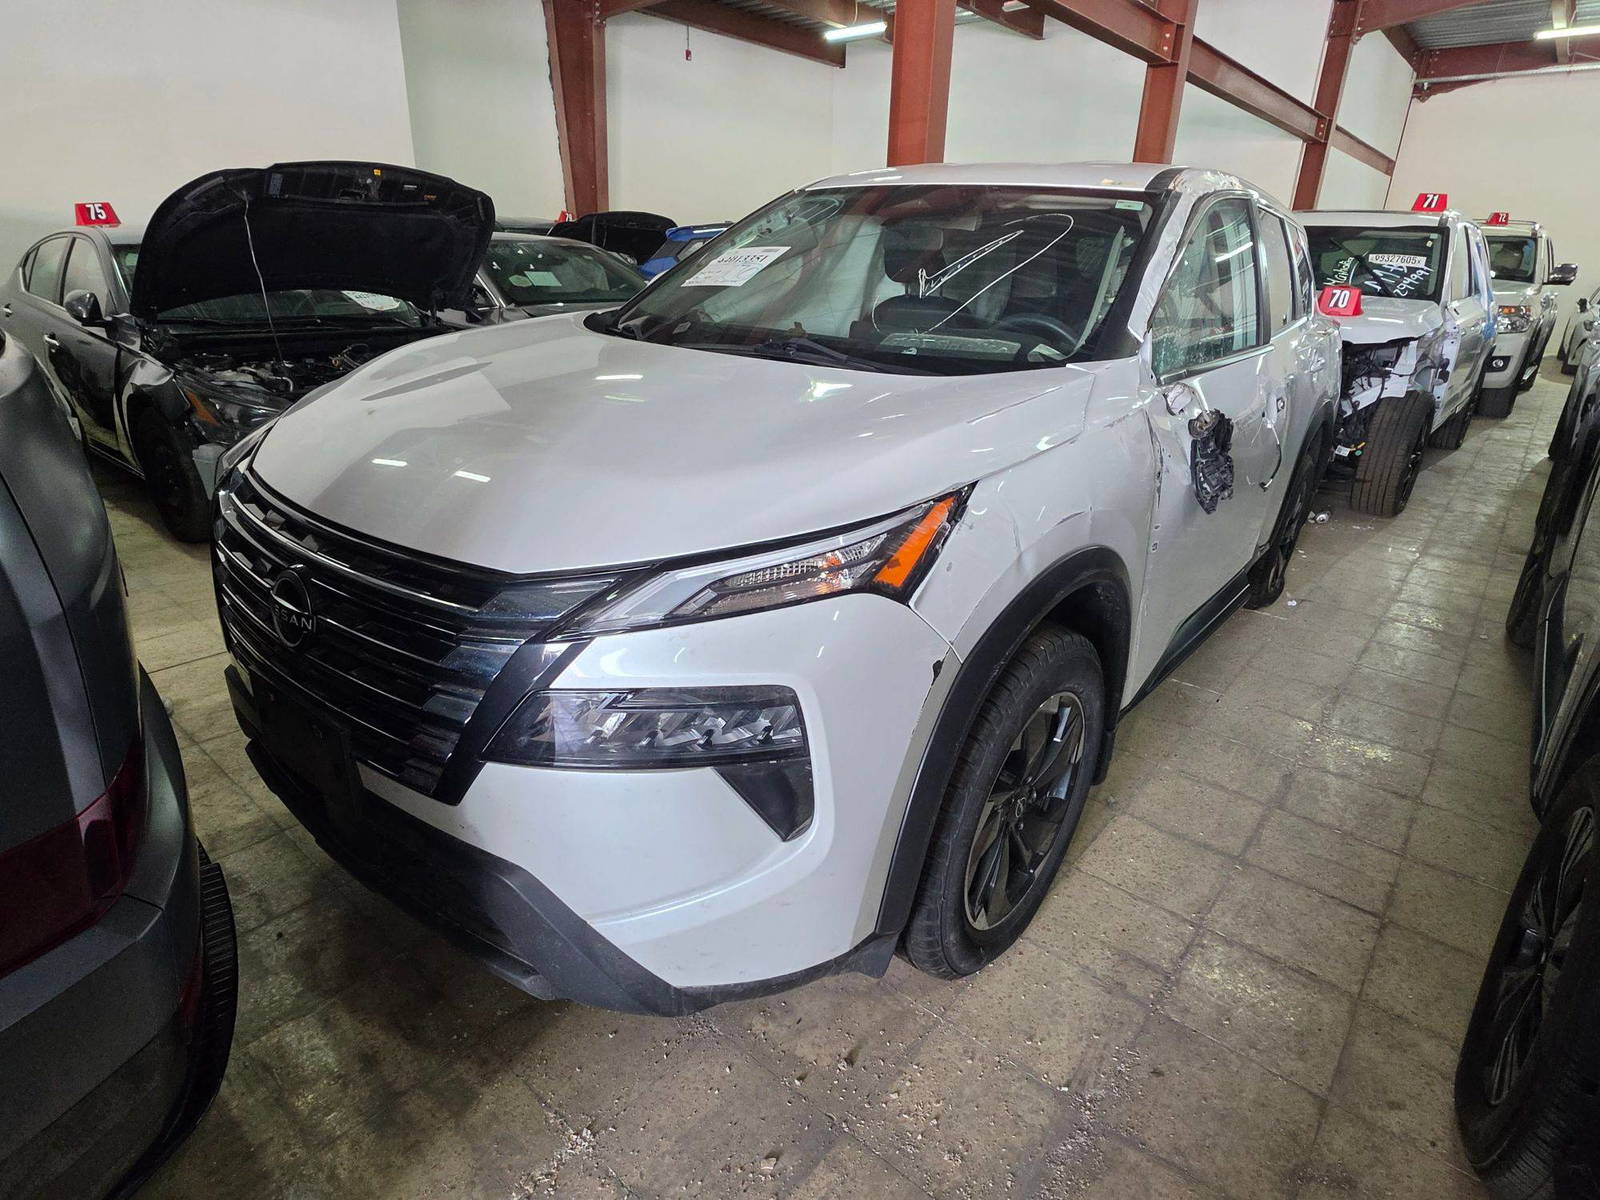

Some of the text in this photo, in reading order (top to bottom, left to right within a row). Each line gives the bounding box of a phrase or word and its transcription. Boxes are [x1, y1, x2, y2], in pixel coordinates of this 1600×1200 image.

[1422, 194, 1439, 209] 71
[85, 203, 107, 220] 75
[1329, 289, 1350, 308] 70
